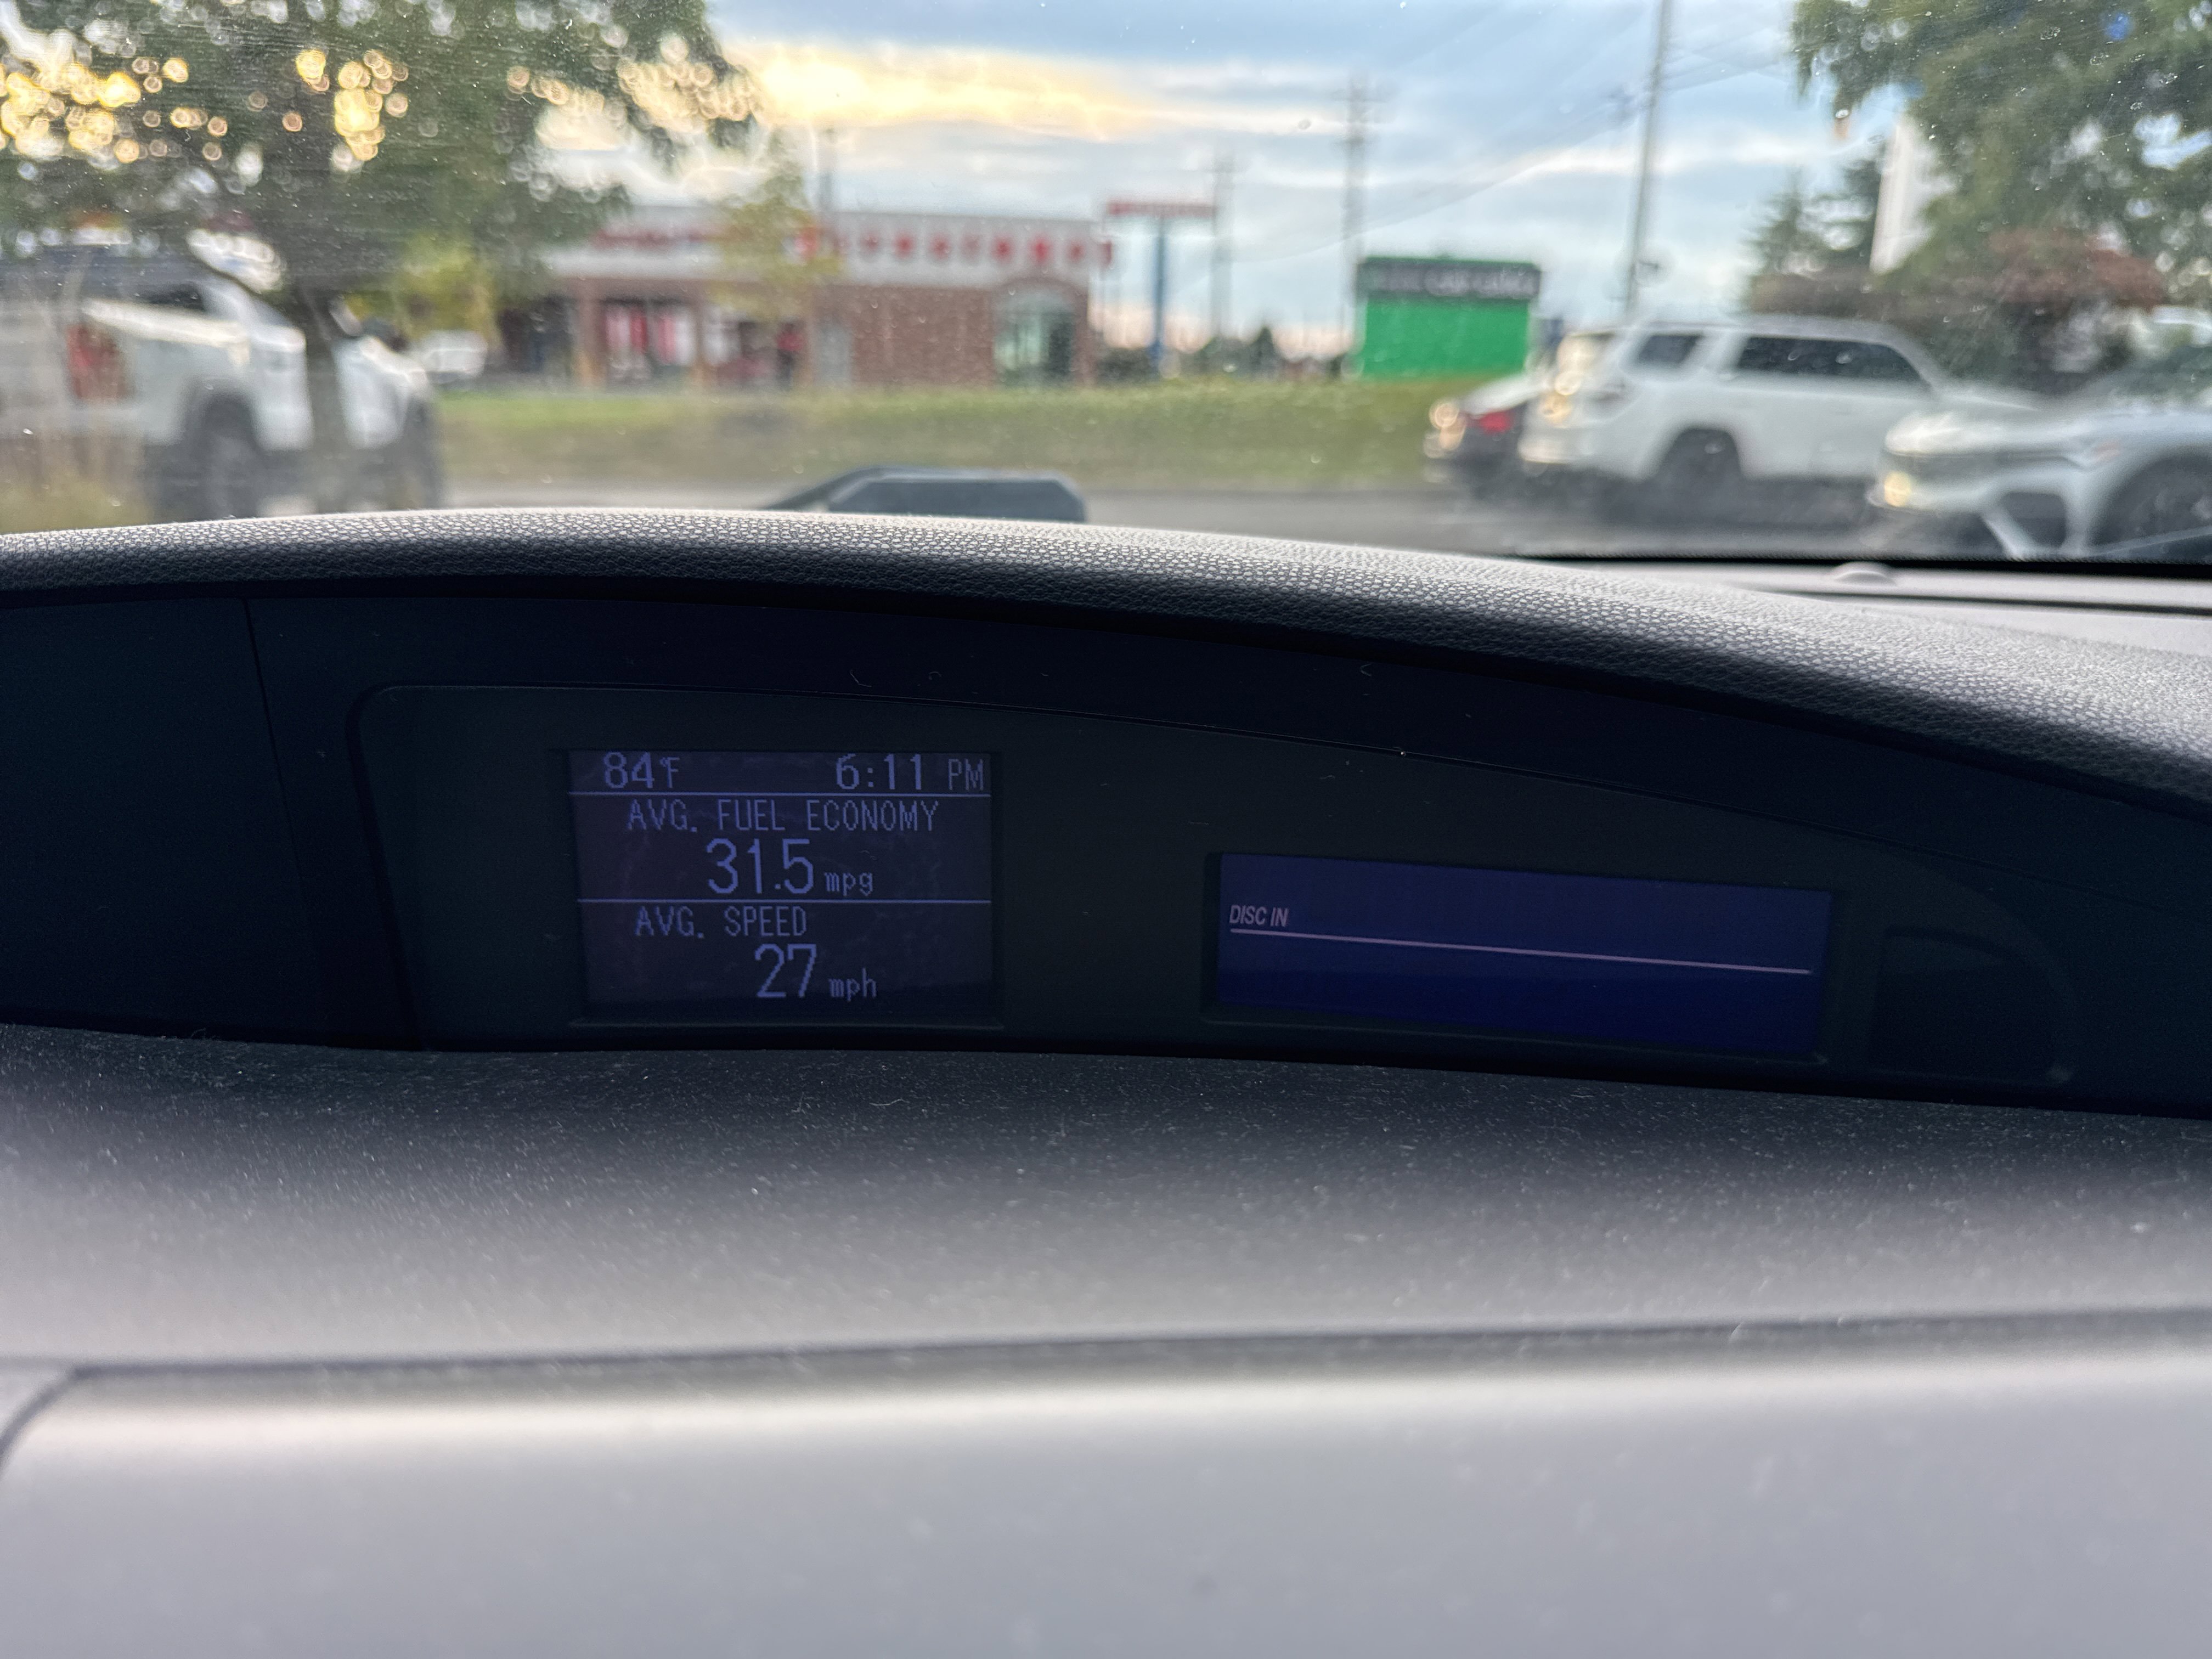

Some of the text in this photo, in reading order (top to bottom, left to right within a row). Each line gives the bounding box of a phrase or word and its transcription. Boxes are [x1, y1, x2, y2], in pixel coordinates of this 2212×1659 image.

[836, 753, 984, 791] 6:11 PM
[627, 798, 939, 832] AVG. FUEL ECONOMY
[706, 838, 873, 896] 31.5 mpg
[635, 906, 806, 939] AVG. SPEED
[1229, 905, 1289, 927] DISC IN
[754, 943, 877, 1001] 27 mph
